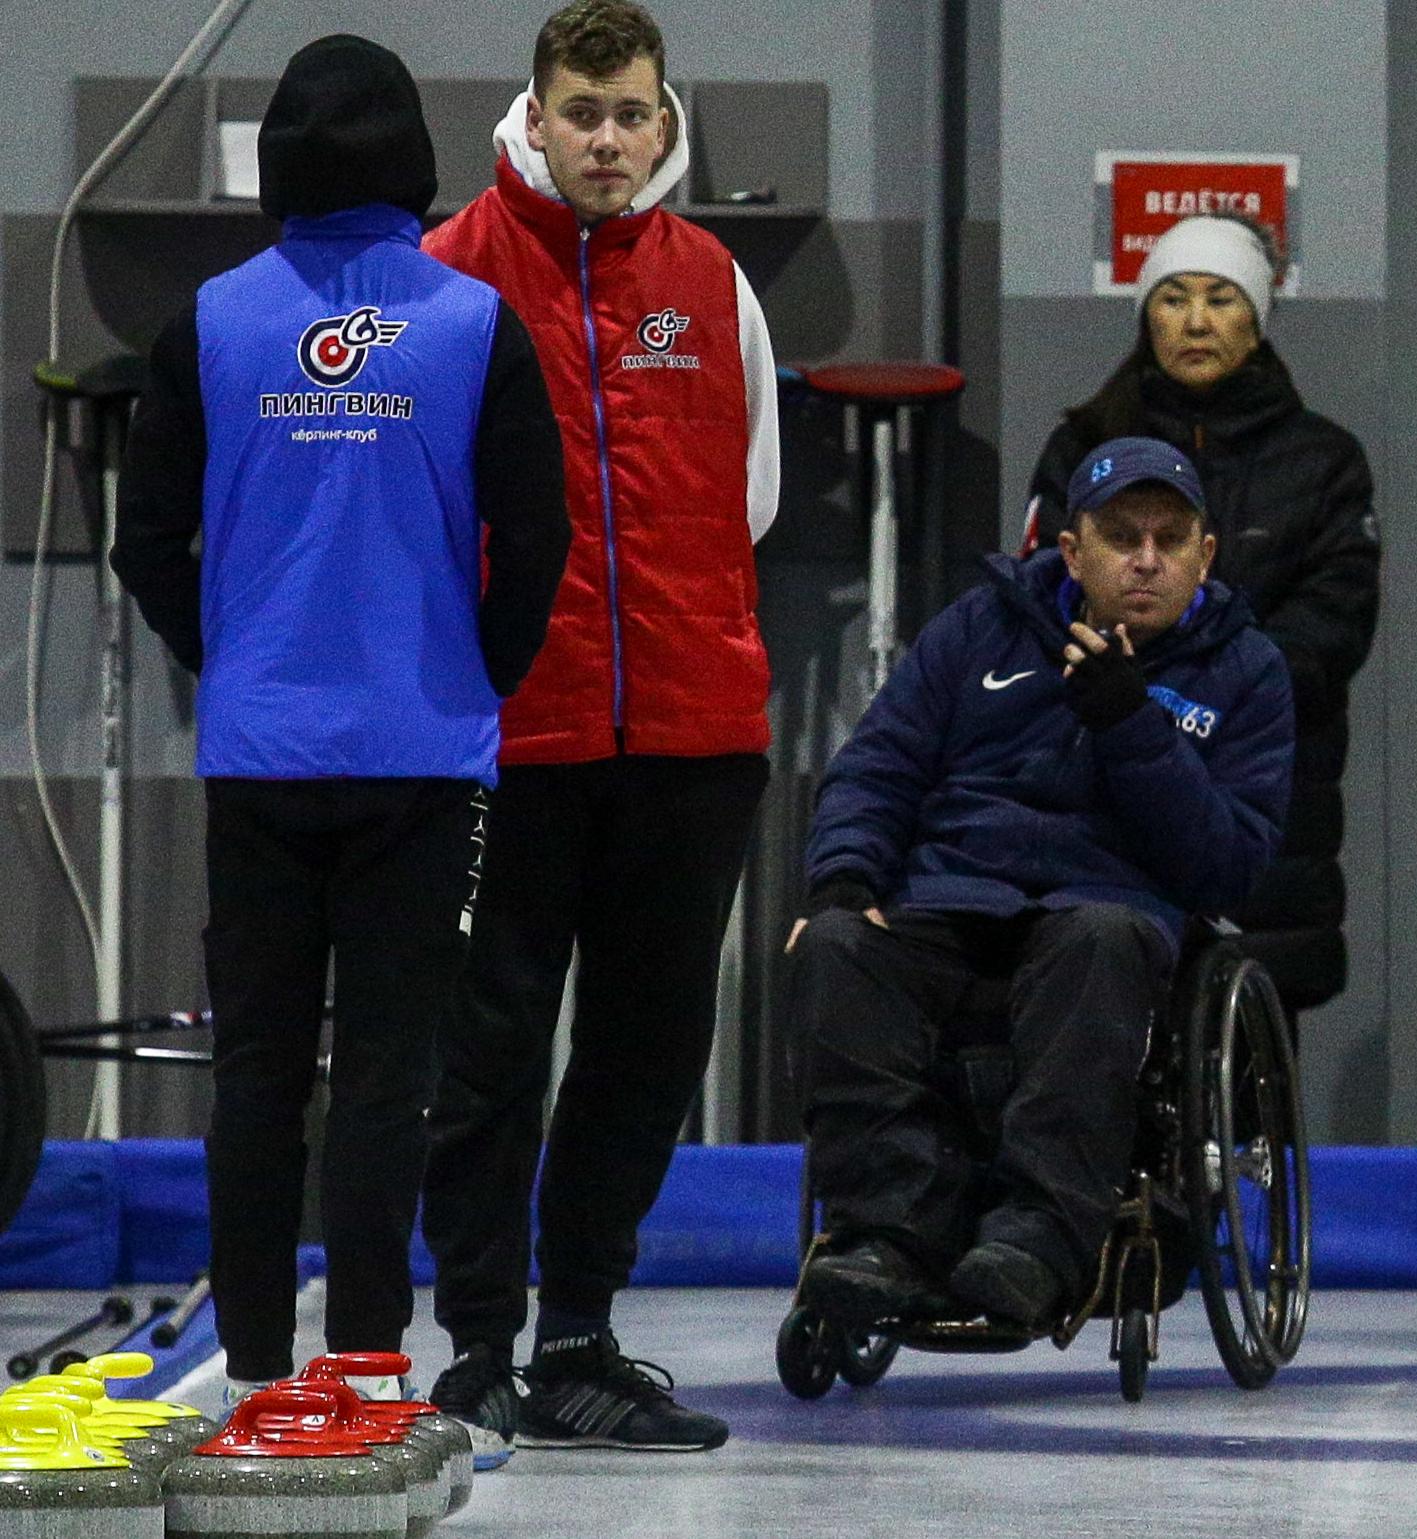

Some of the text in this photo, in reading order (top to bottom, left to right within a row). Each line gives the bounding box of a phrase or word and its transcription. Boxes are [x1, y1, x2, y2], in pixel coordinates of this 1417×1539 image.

[1144, 187, 1260, 214] ВЕДЁТСЯ
[260, 391, 413, 419] ПИНГВИН
[291, 428, 377, 443] кёрлинг-клуб
[1092, 459, 1112, 482] 63
[1182, 706, 1216, 738] 63
